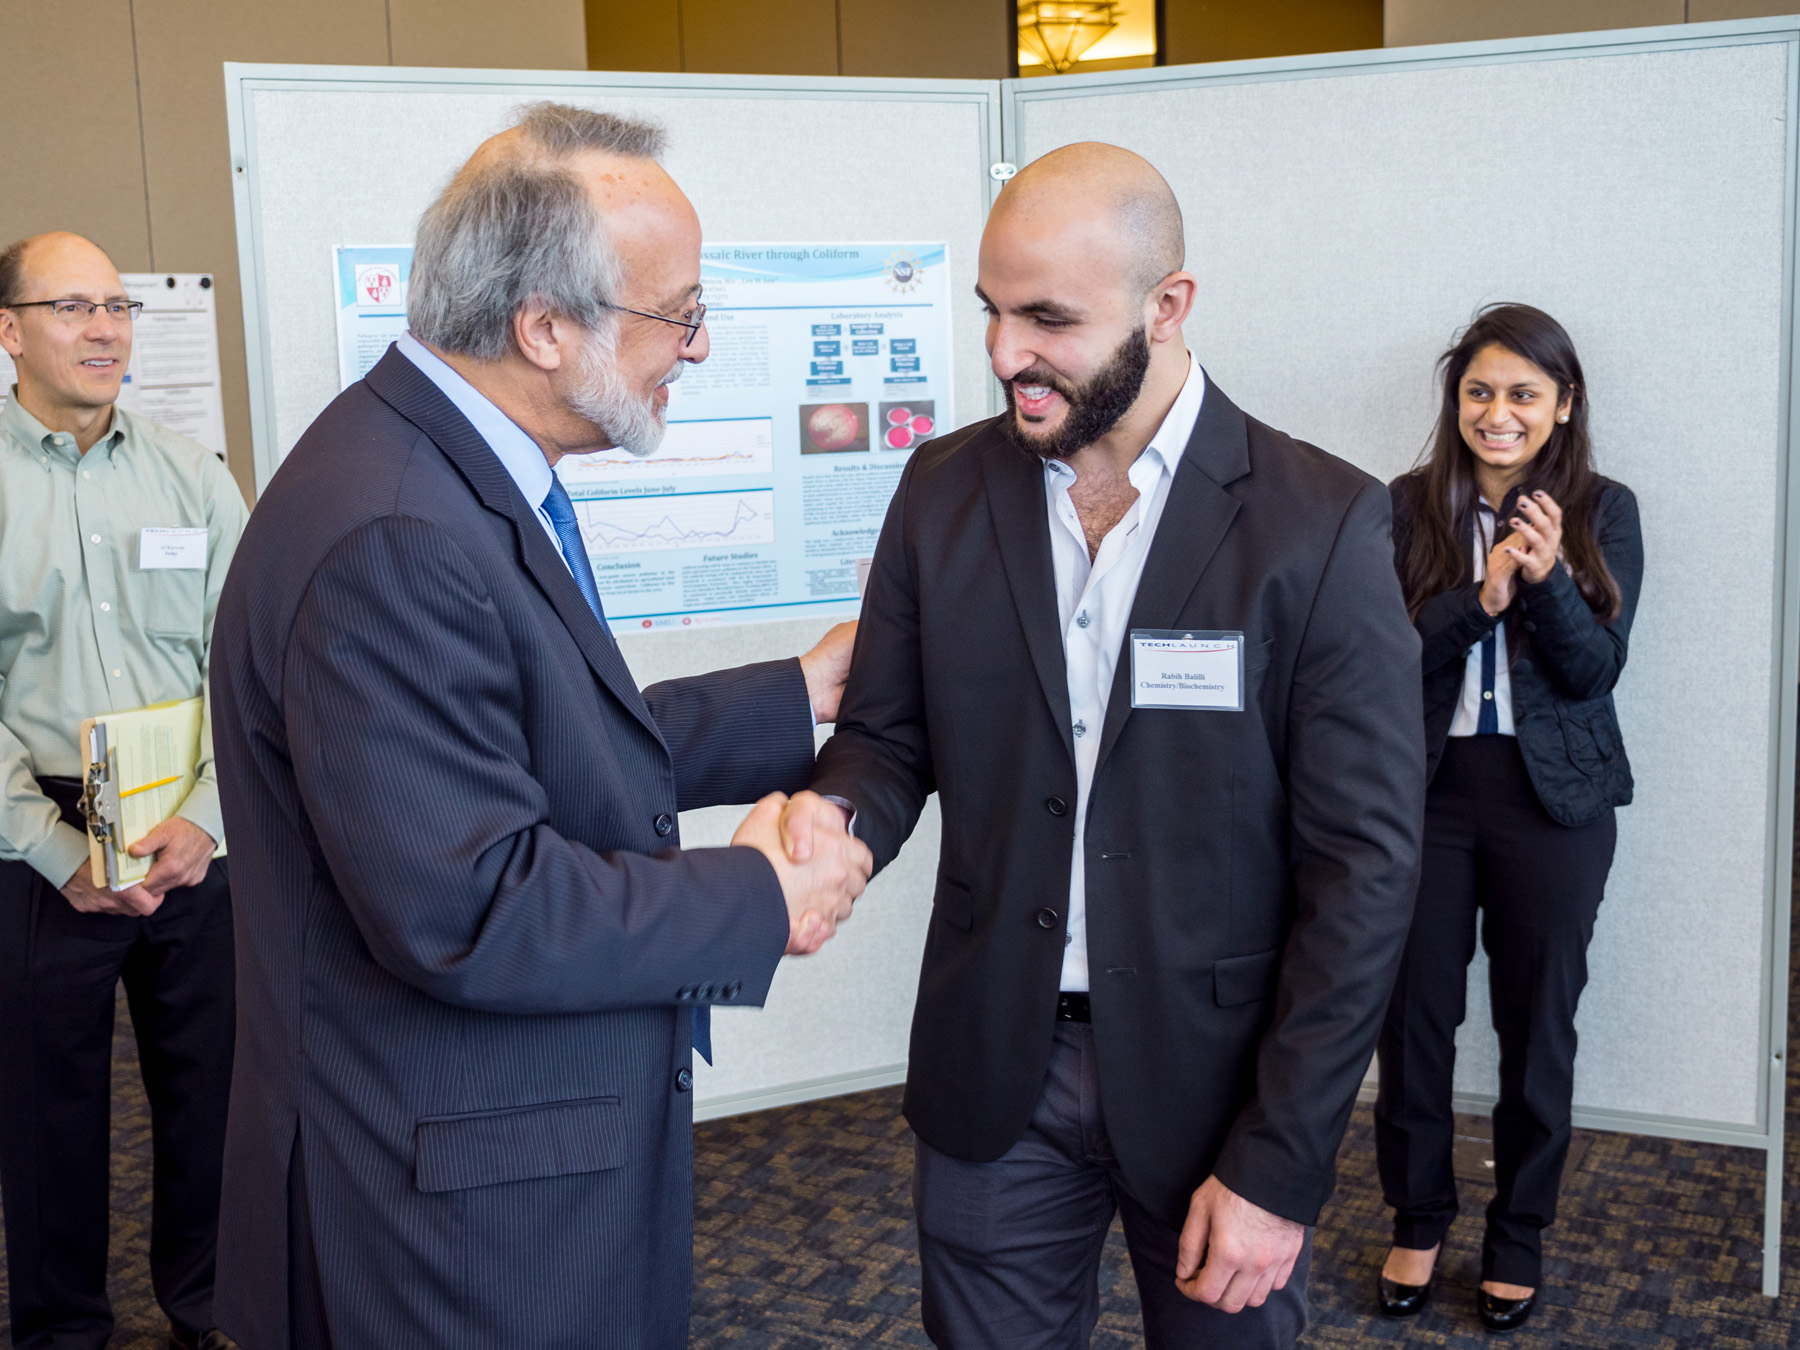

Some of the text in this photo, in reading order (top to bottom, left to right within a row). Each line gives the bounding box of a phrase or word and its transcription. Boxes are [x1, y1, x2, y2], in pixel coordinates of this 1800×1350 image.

[700, 248, 860, 262] ssaic River through Coliform
[894, 267, 913, 277] NSF
[831, 311, 904, 321] Laboratory Analysis
[833, 464, 860, 472] Results
[587, 487, 618, 496] Coliform
[620, 486, 642, 494] Levels
[703, 552, 758, 562] Future Studies
[597, 561, 641, 571] Conclusion
[1161, 672, 1182, 680] Rabih
[1140, 681, 1225, 692] Chemistry/Biochemistry
